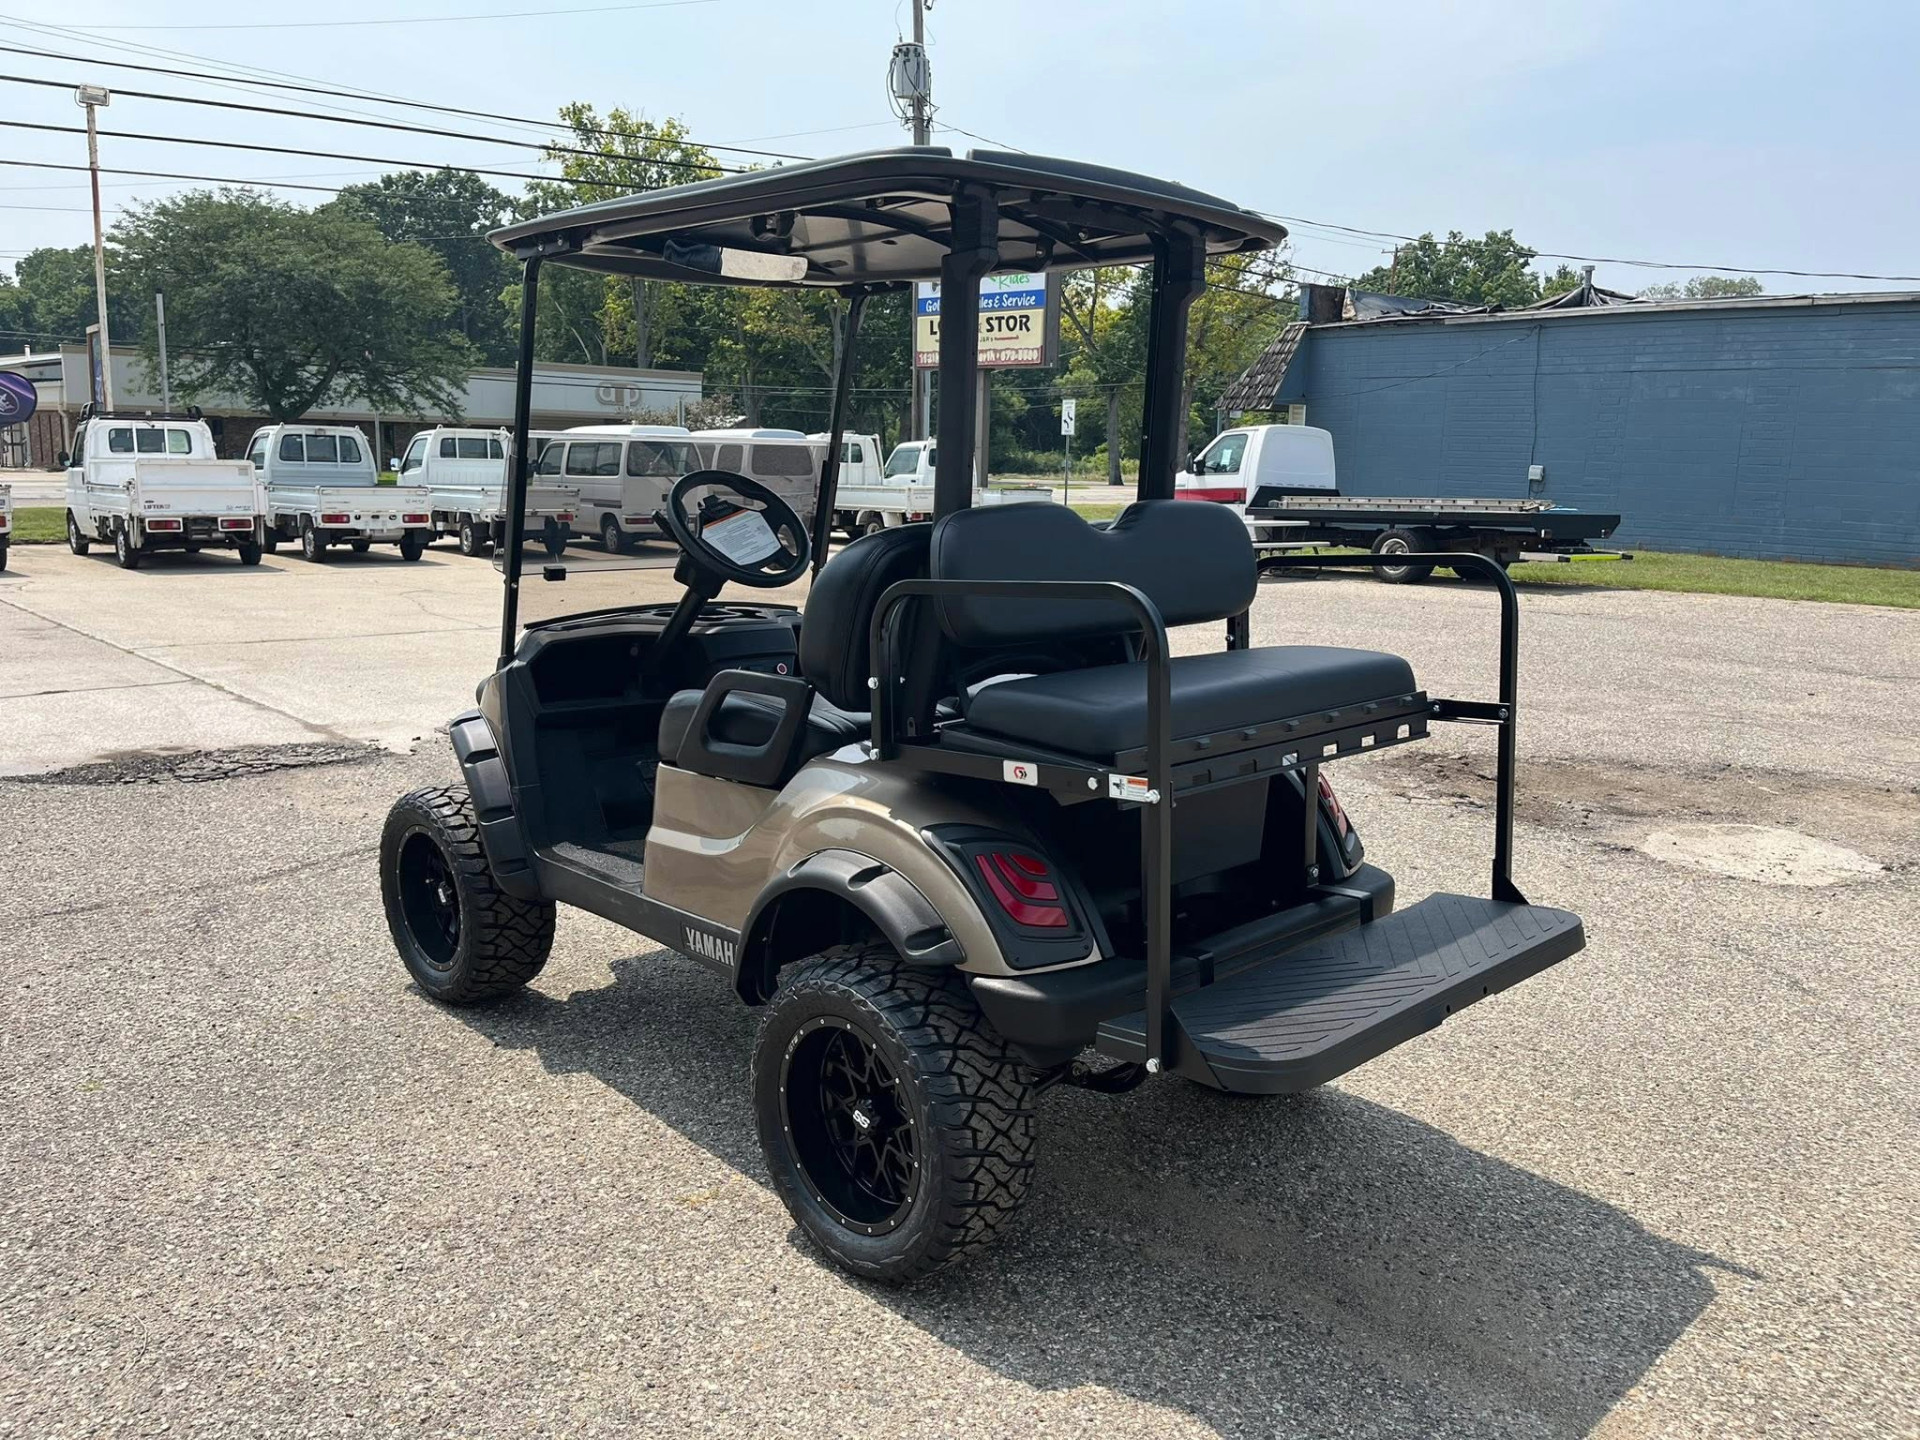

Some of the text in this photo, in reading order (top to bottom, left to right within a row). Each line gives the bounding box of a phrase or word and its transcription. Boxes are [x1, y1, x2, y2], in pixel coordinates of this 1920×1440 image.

[925, 300, 940, 313] Gol
[1001, 293, 1036, 308] Service
[985, 314, 1031, 333] STOR
[685, 926, 738, 967] YAMAH
